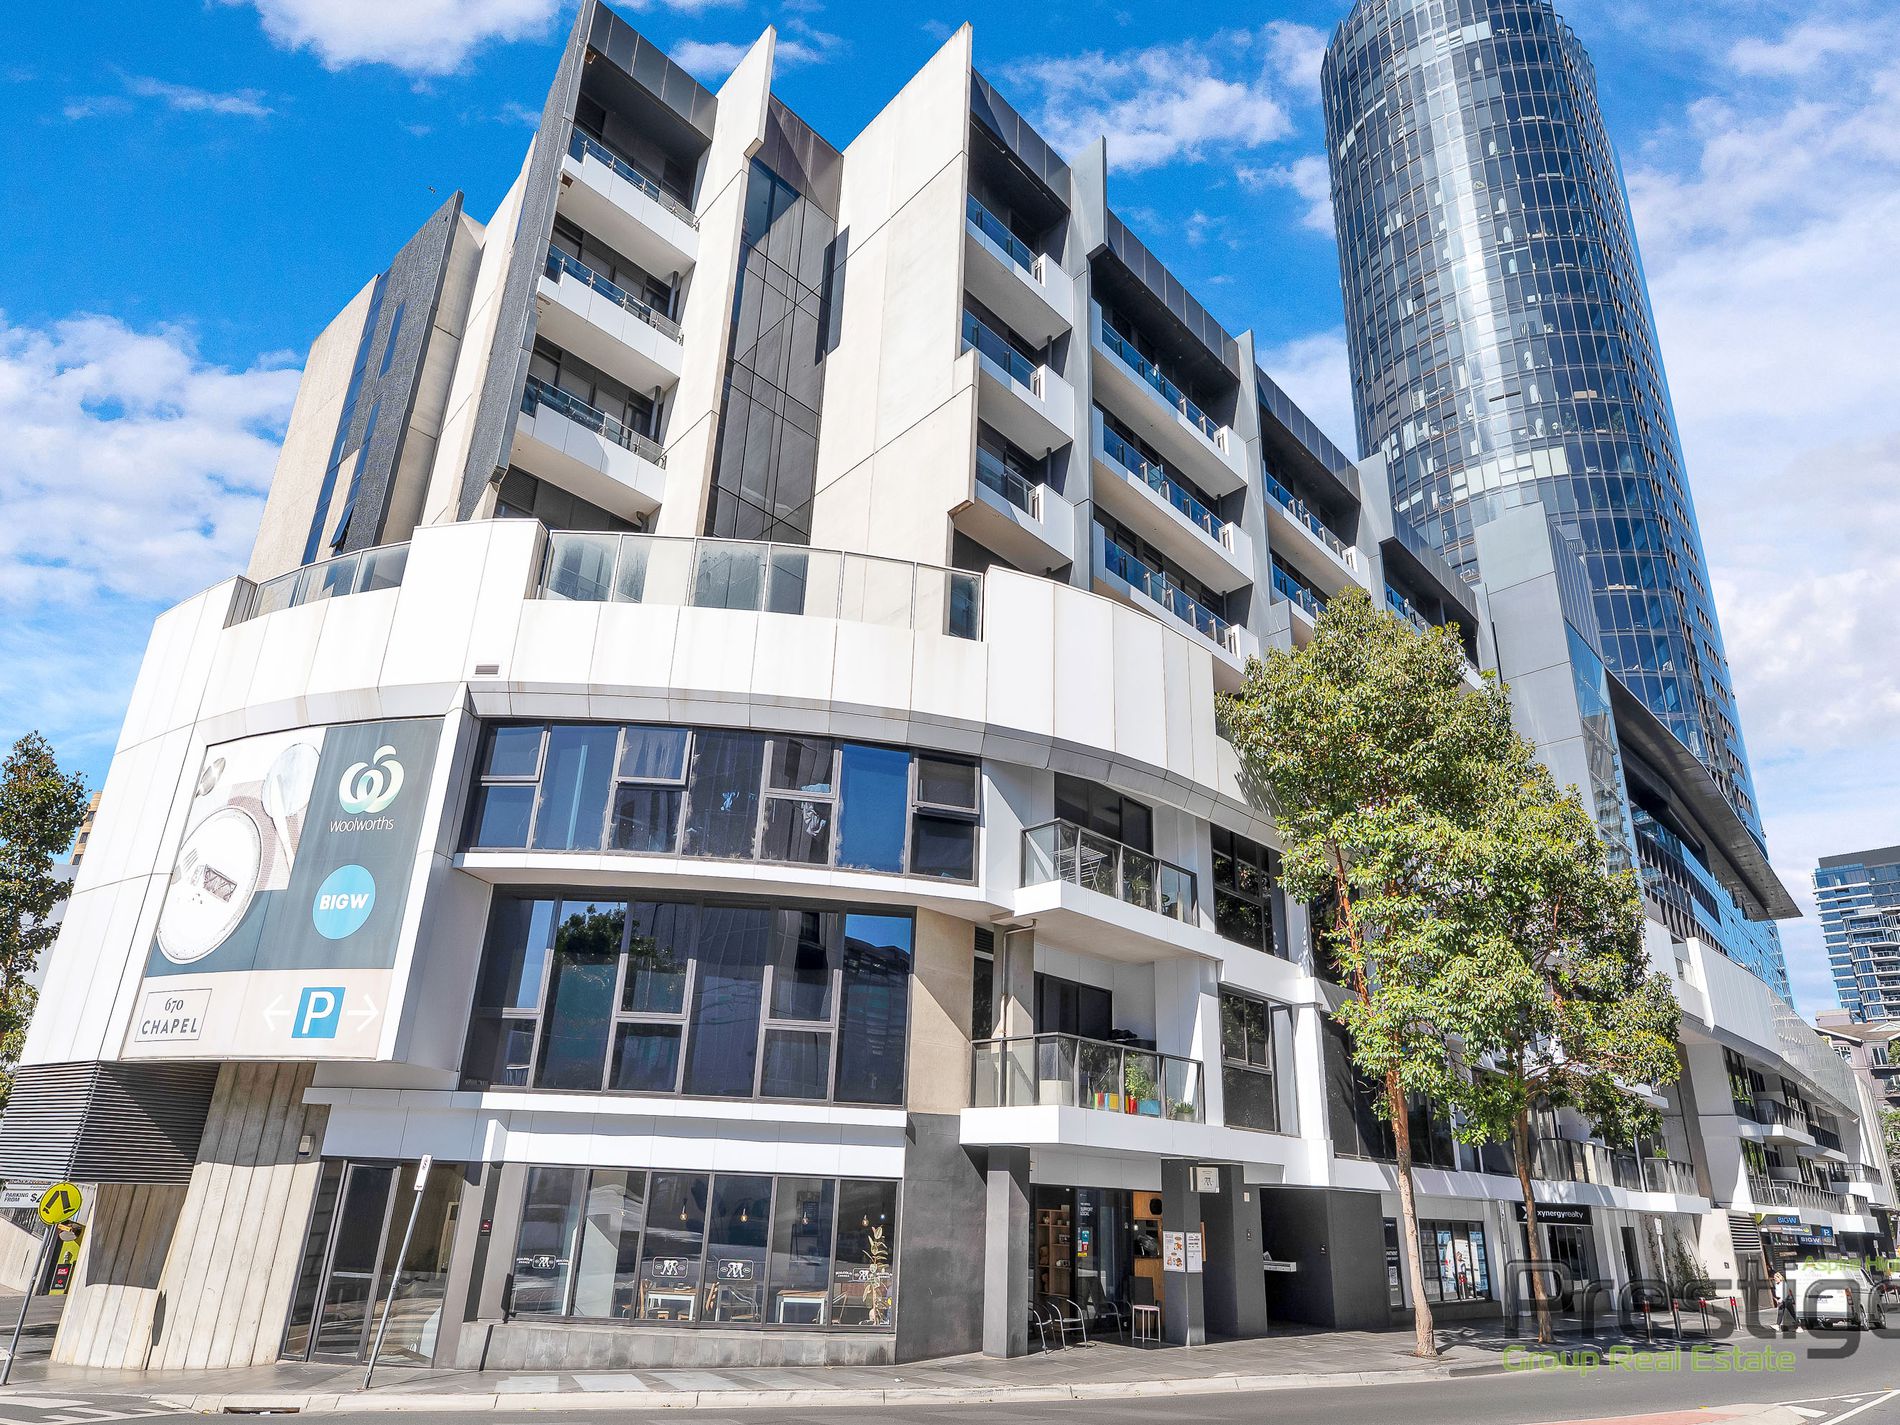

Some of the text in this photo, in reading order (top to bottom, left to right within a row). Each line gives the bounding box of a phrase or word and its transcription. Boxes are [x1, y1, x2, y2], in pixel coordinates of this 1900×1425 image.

[164, 997, 184, 1014] 670
[302, 990, 336, 1035] P
[141, 1017, 199, 1036] CHAPEL
